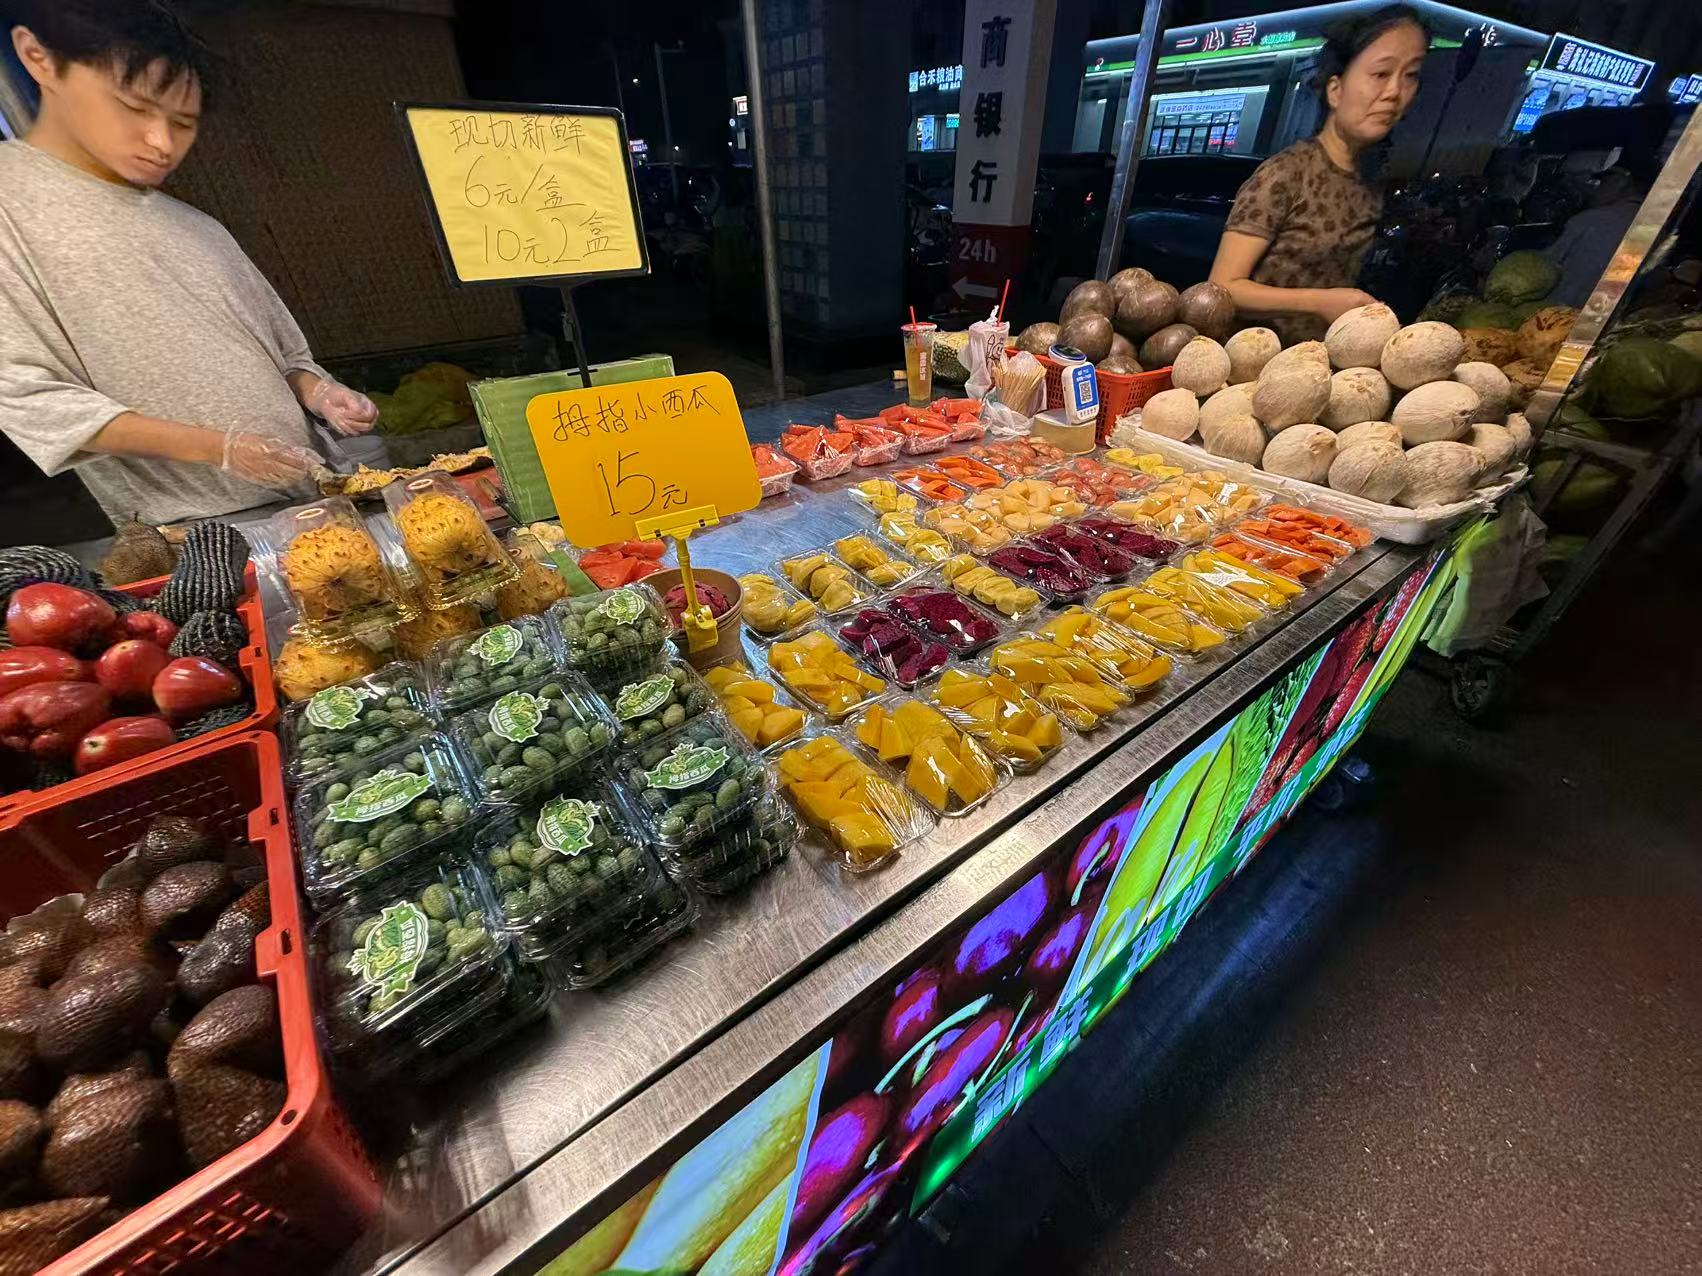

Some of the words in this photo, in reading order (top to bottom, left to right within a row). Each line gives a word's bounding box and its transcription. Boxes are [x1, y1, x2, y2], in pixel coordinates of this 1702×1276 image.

[1175, 20, 1257, 53] 一心堂
[450, 113, 586, 155] 现切新鲜
[464, 154, 586, 212] 6元/盒
[482, 210, 622, 265] 10元2盒
[958, 237, 997, 264] 24h
[552, 384, 721, 443] 拇指小西瓜
[598, 450, 689, 518] 15元
[970, 987, 1094, 1144] 新鲜
